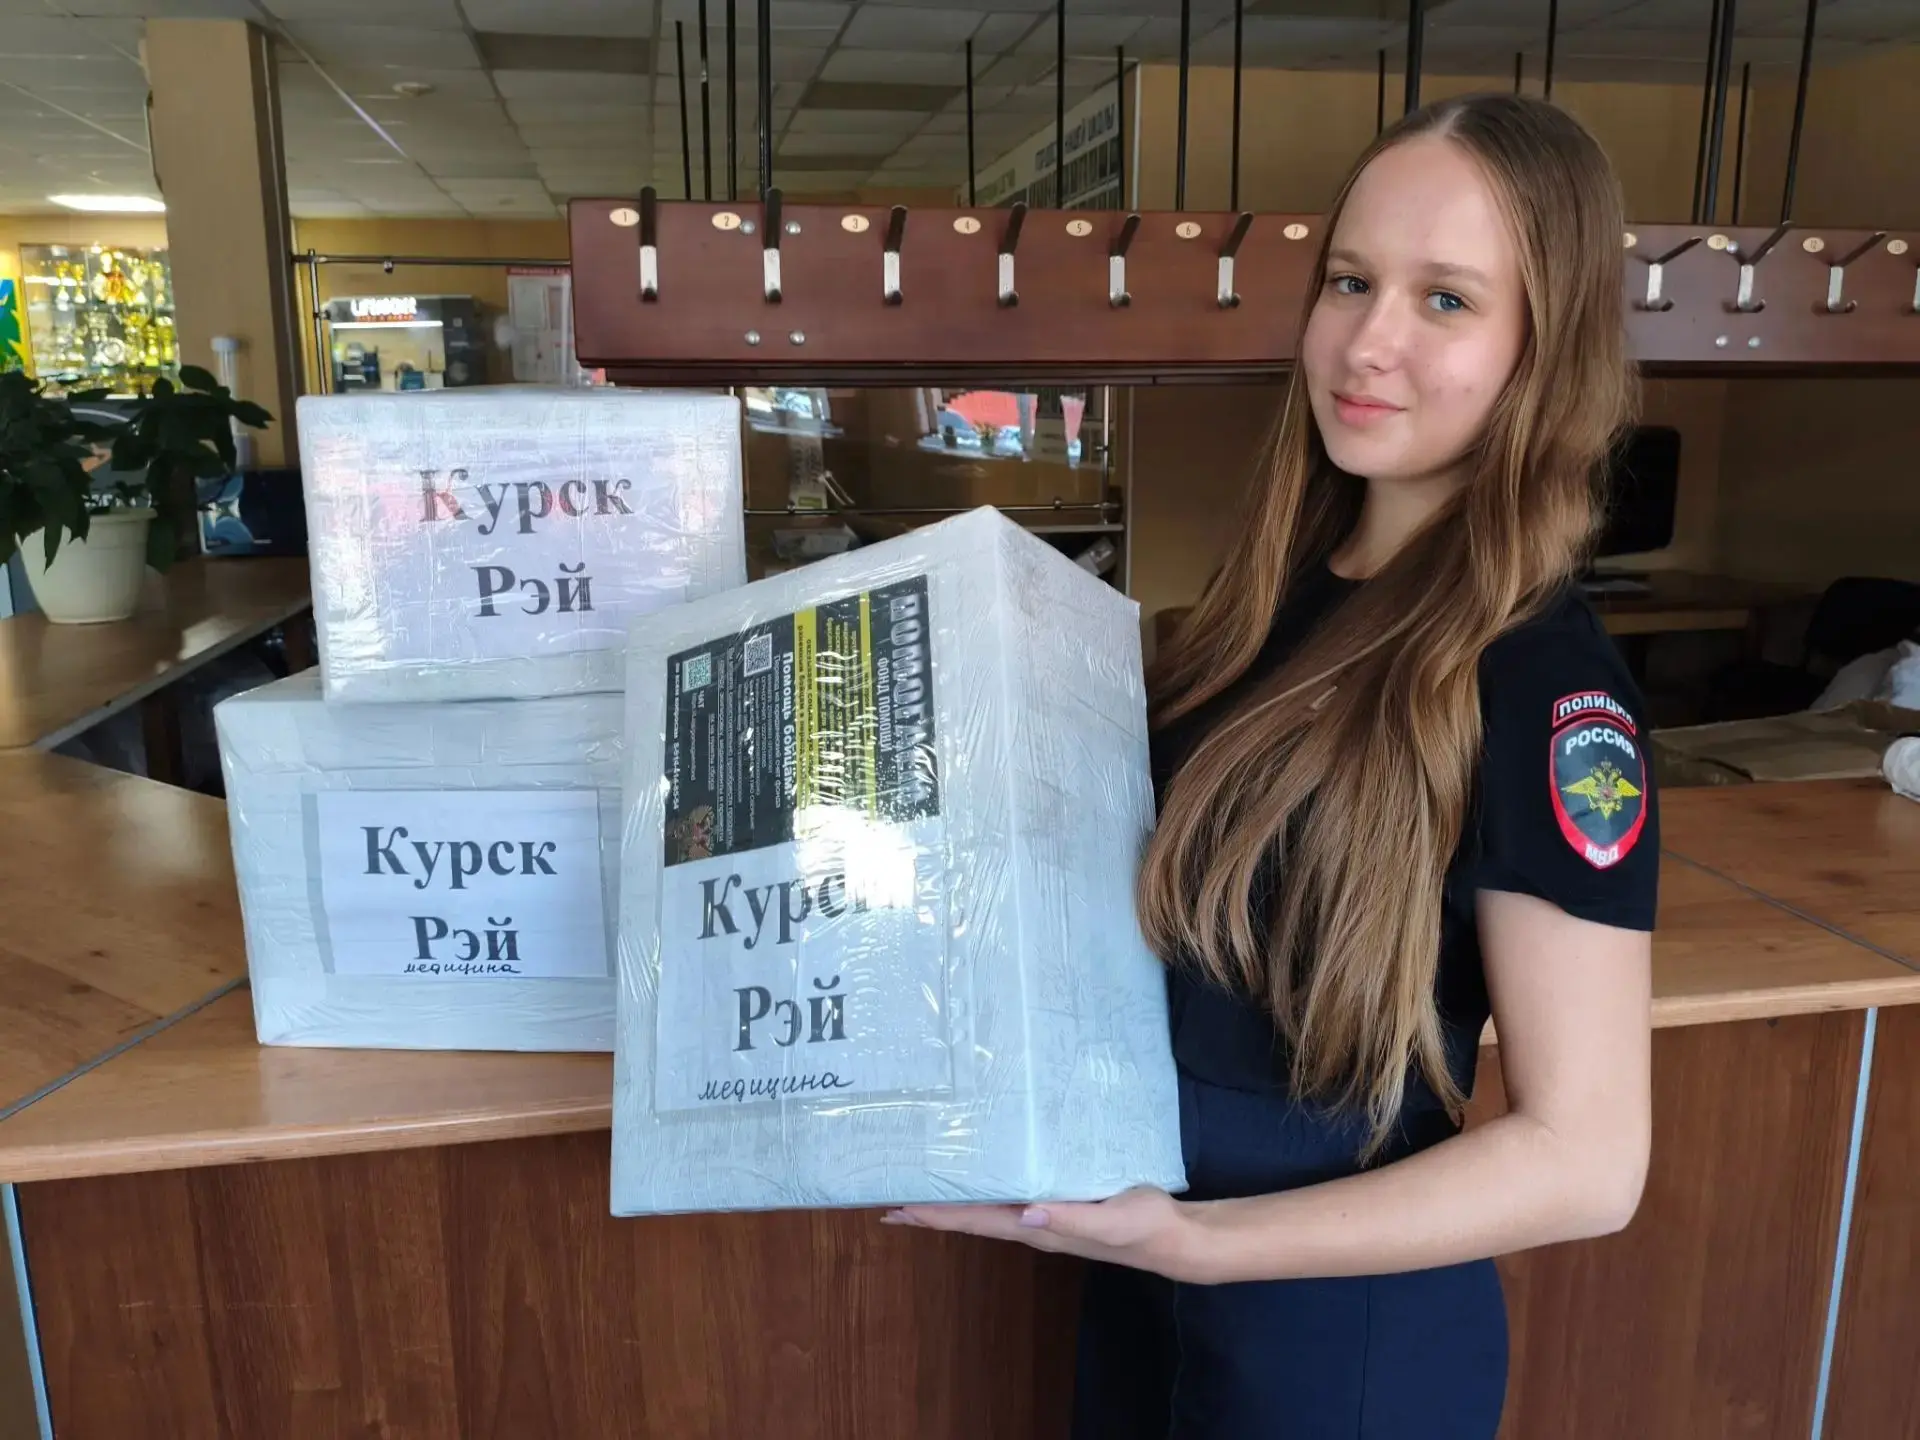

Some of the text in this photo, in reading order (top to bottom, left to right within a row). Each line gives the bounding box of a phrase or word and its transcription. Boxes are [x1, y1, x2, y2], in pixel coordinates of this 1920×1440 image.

[414, 468, 635, 535] Курск
[470, 562, 595, 617] Рэй
[780, 650, 794, 721] Помощь
[877, 657, 892, 753] ФОНД ПОМОЩИ
[1565, 727, 1635, 759] РОССИЯ
[360, 826, 558, 889] Курск
[1585, 843, 1619, 866] МВД
[407, 916, 521, 961] Рэй
[697, 873, 894, 950] Курс
[403, 961, 522, 975] медицина
[732, 975, 848, 1052] Рэй
[698, 1071, 855, 1102] медицина
